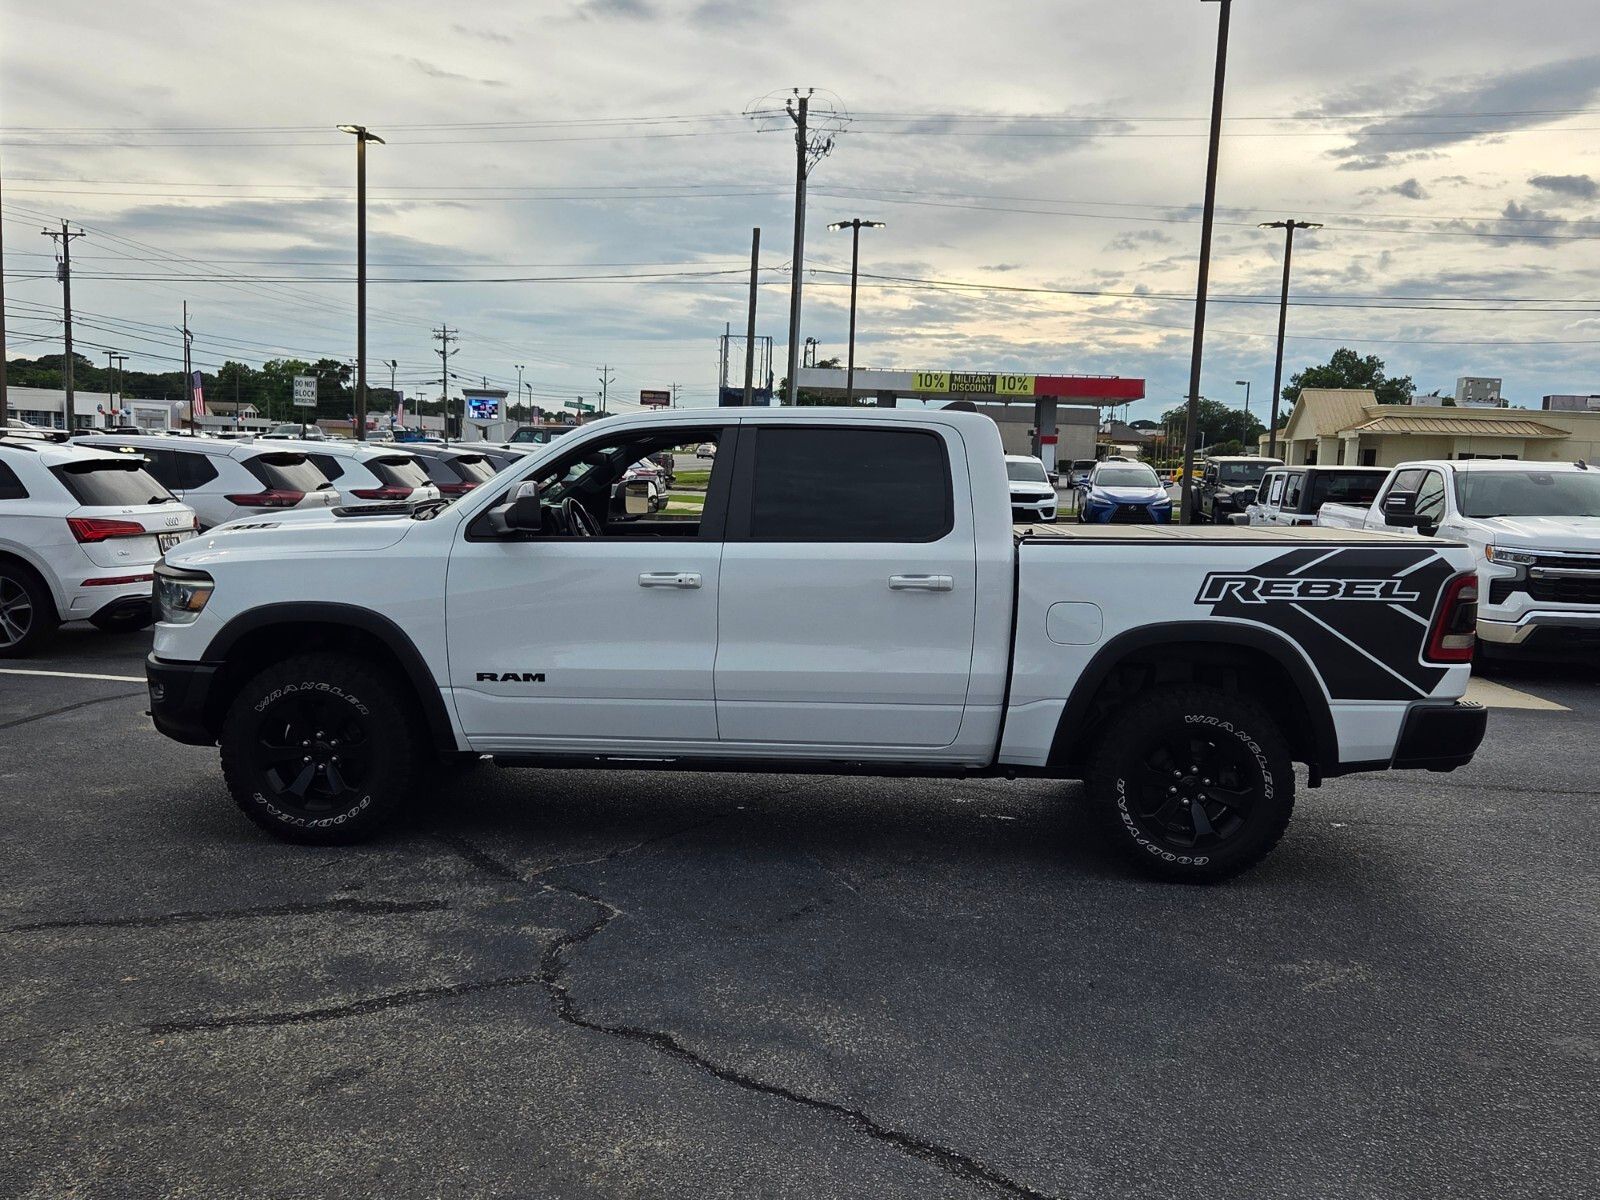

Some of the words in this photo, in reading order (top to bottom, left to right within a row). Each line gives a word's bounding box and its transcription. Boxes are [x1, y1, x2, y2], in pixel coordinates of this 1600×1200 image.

[918, 373, 945, 388] 10%
[953, 375, 992, 384] MILITARY
[1001, 376, 1028, 391] 10%
[295, 389, 315, 398] BLOCK
[951, 383, 994, 392] DISCOUNT!
[1196, 574, 1420, 604] REBEL
[476, 672, 546, 682] RAM
[254, 682, 370, 715] WRANGLER
[1184, 714, 1274, 800] WRANGLER
[253, 792, 371, 828] GOODYEAR
[1116, 777, 1210, 866] GOODYEAR
